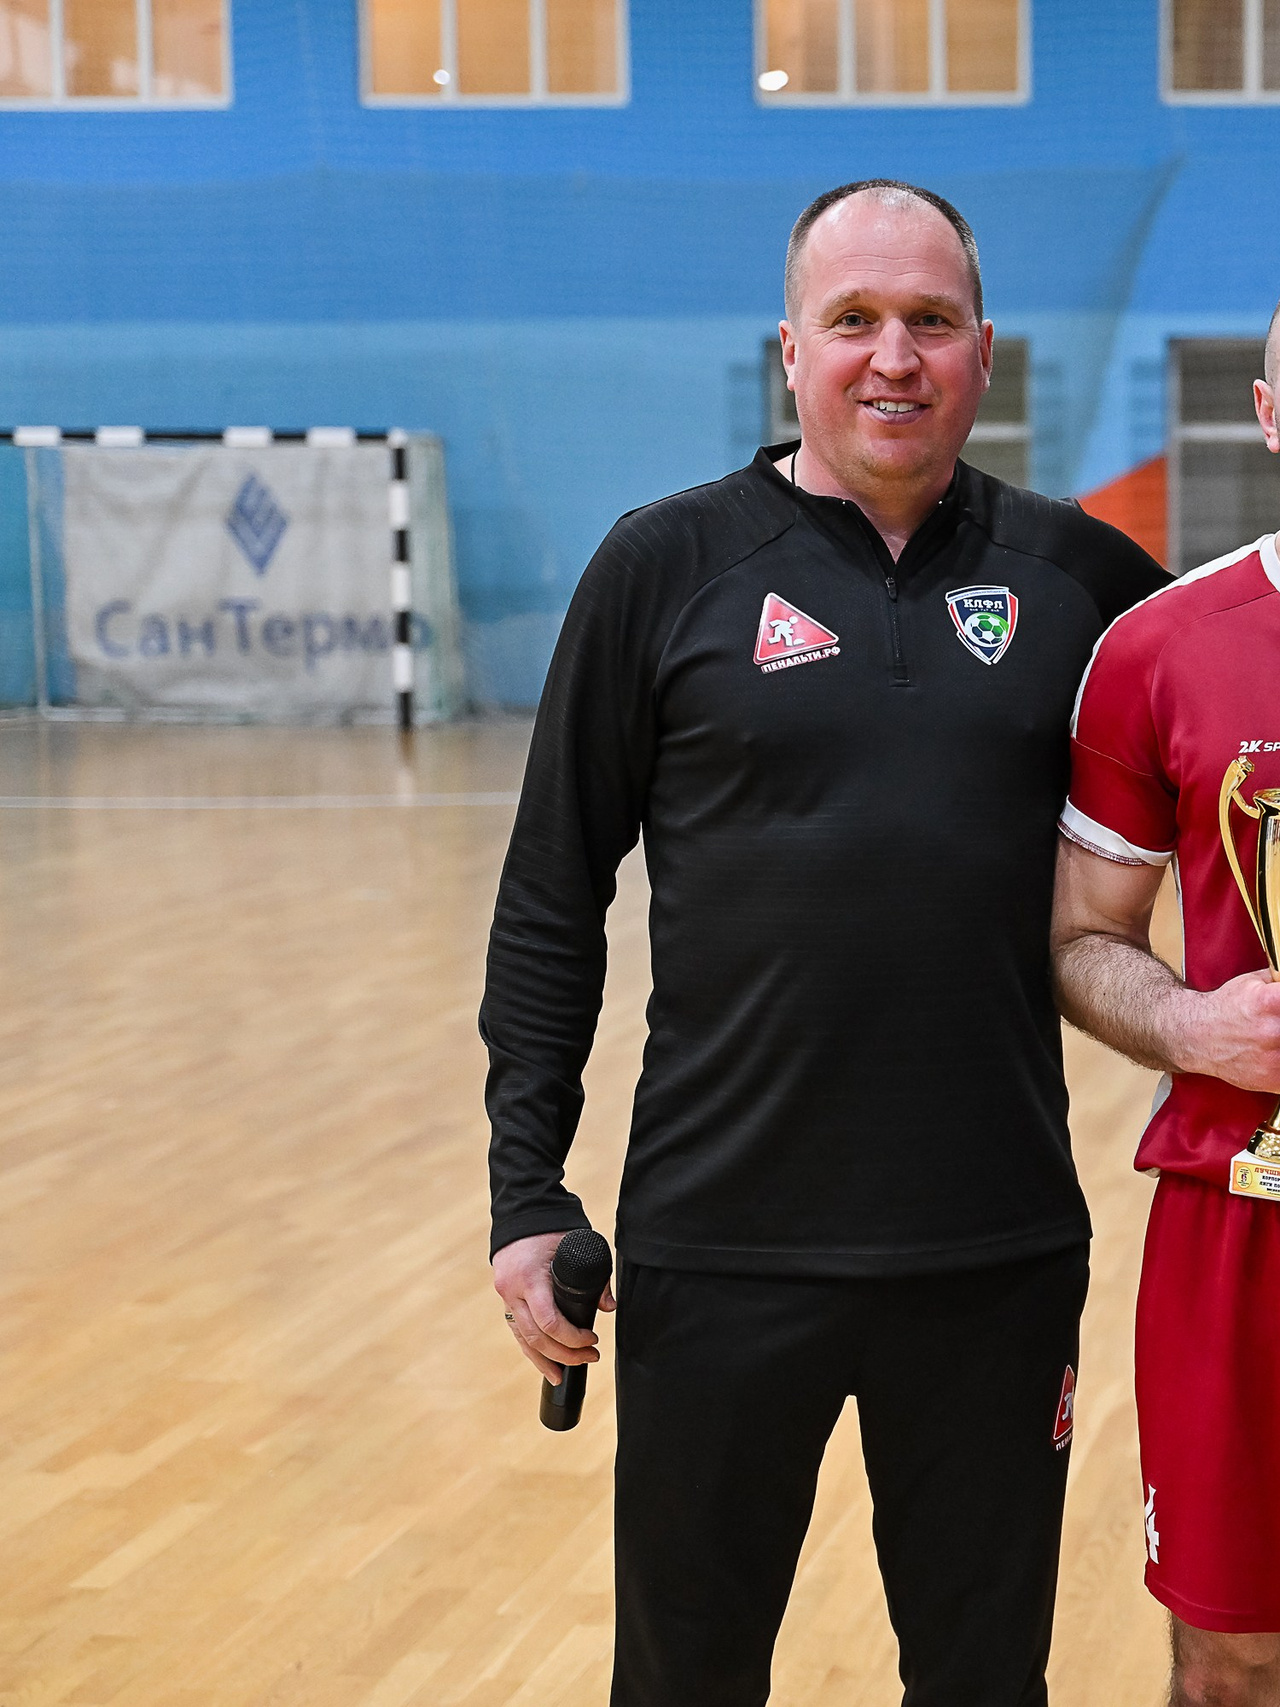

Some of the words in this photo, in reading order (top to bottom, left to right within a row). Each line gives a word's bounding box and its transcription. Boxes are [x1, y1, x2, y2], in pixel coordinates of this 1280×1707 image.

[963, 598, 1004, 610] КЛФЛ
[761, 646, 841, 674] ПЕНАЛЬТИ.РФ
[1238, 740, 1264, 754] 2K
